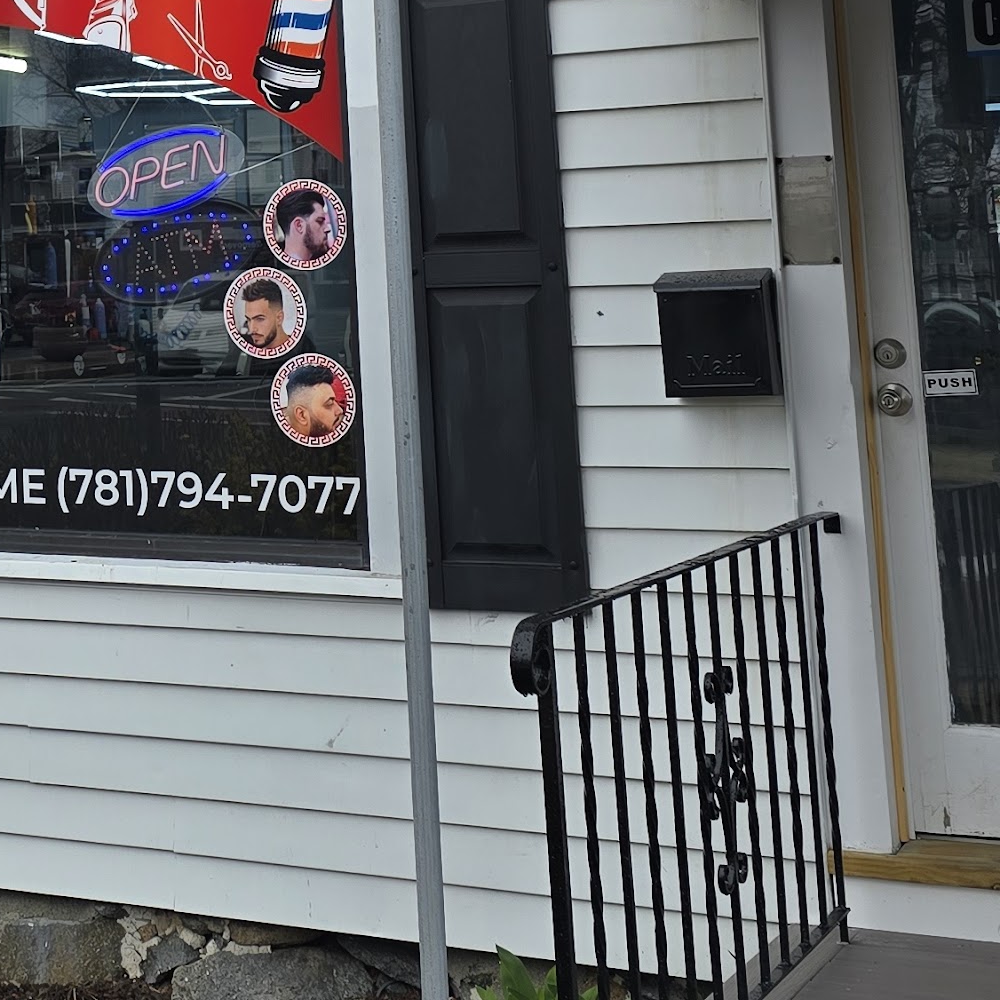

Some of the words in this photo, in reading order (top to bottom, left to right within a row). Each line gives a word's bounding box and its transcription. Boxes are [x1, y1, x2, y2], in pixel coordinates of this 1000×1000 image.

[95, 134, 226, 208] OPEN
[134, 219, 229, 286] ATM
[686, 353, 746, 376] Mail
[926, 377, 973, 389] PUSH
[56, 465, 362, 516] (781)794-7077
